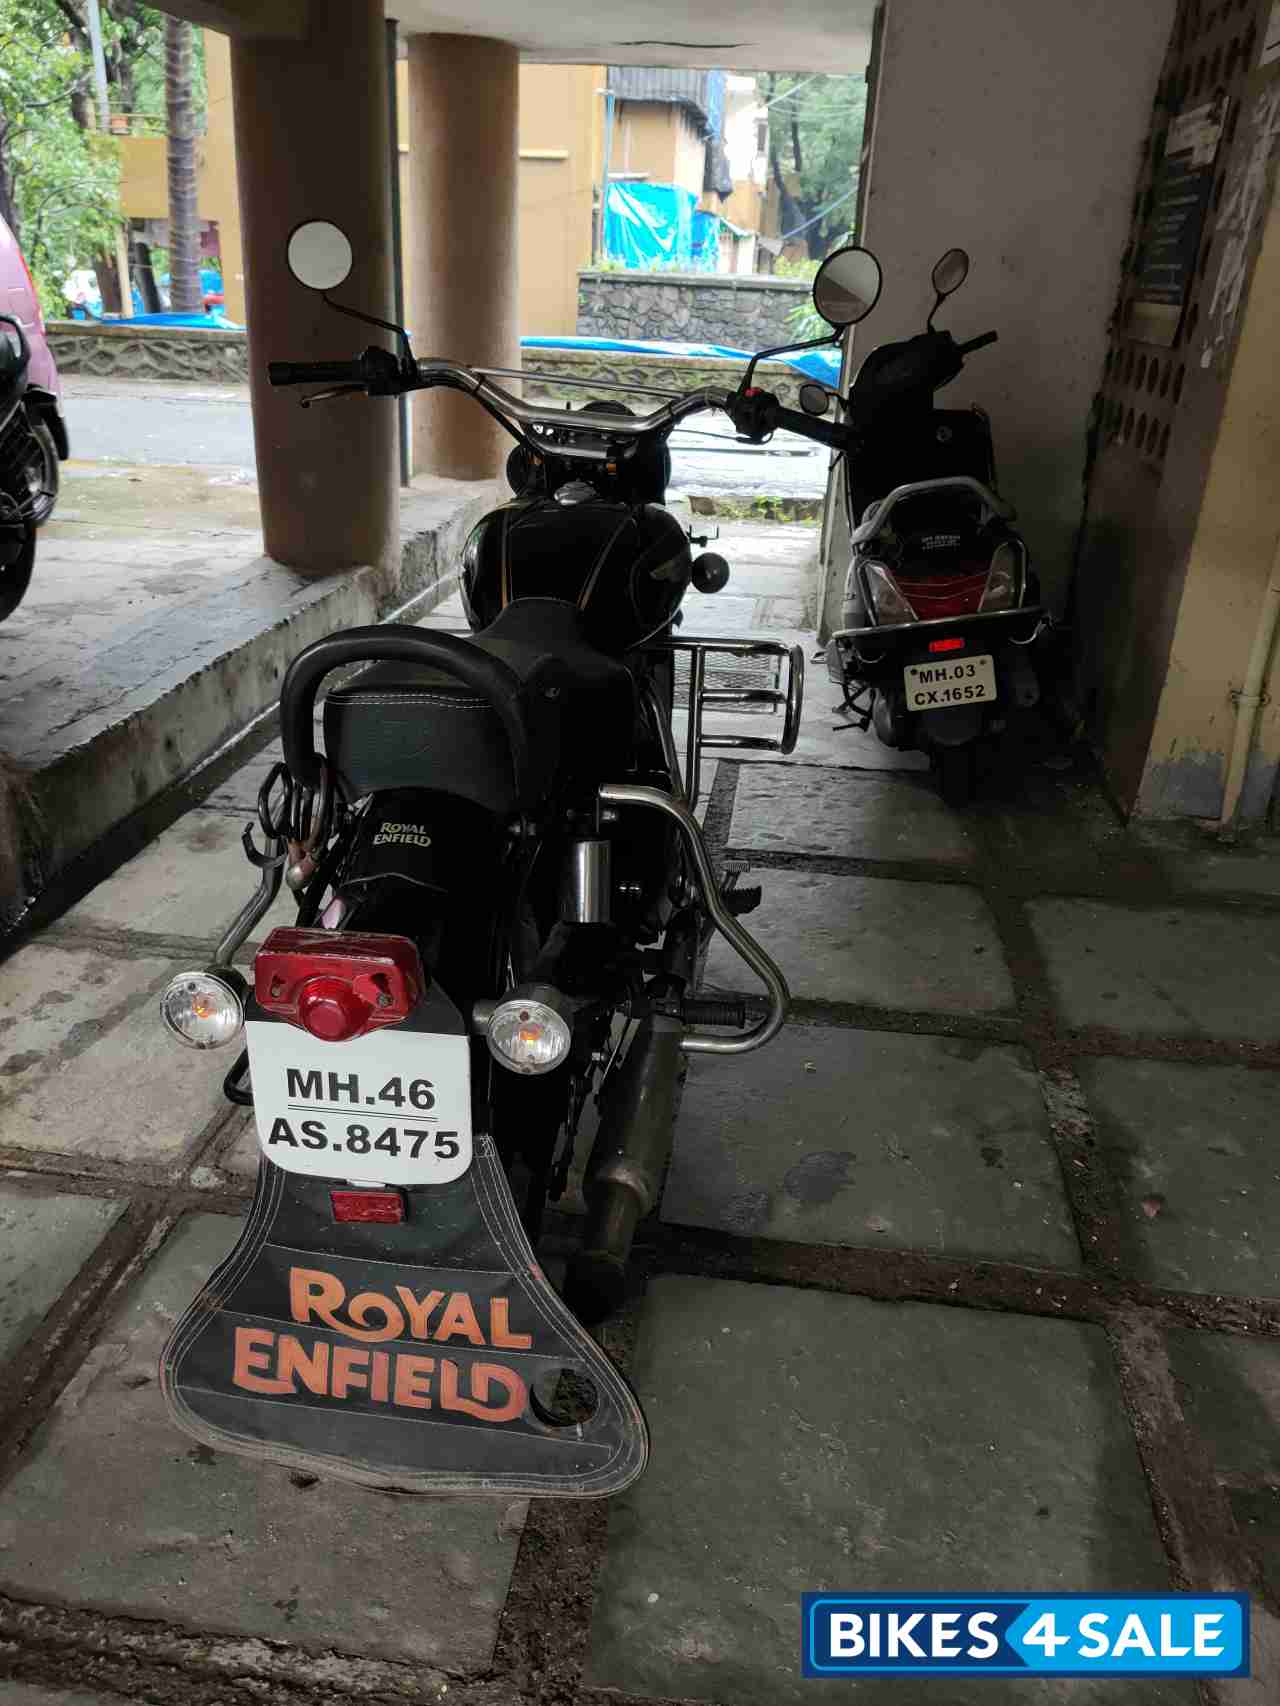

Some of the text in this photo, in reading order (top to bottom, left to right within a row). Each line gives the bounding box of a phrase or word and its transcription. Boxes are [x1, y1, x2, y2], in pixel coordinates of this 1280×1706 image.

[919, 664, 976, 684] MH.03
[914, 684, 986, 705] CX.1652
[373, 833, 432, 847] ENFIELD
[380, 822, 427, 834] ROYAL
[286, 1067, 436, 1110] MH.46
[268, 1117, 461, 1160] AS.8475
[289, 1266, 532, 1350] ROYAL
[232, 1326, 529, 1424] ENFIELD
